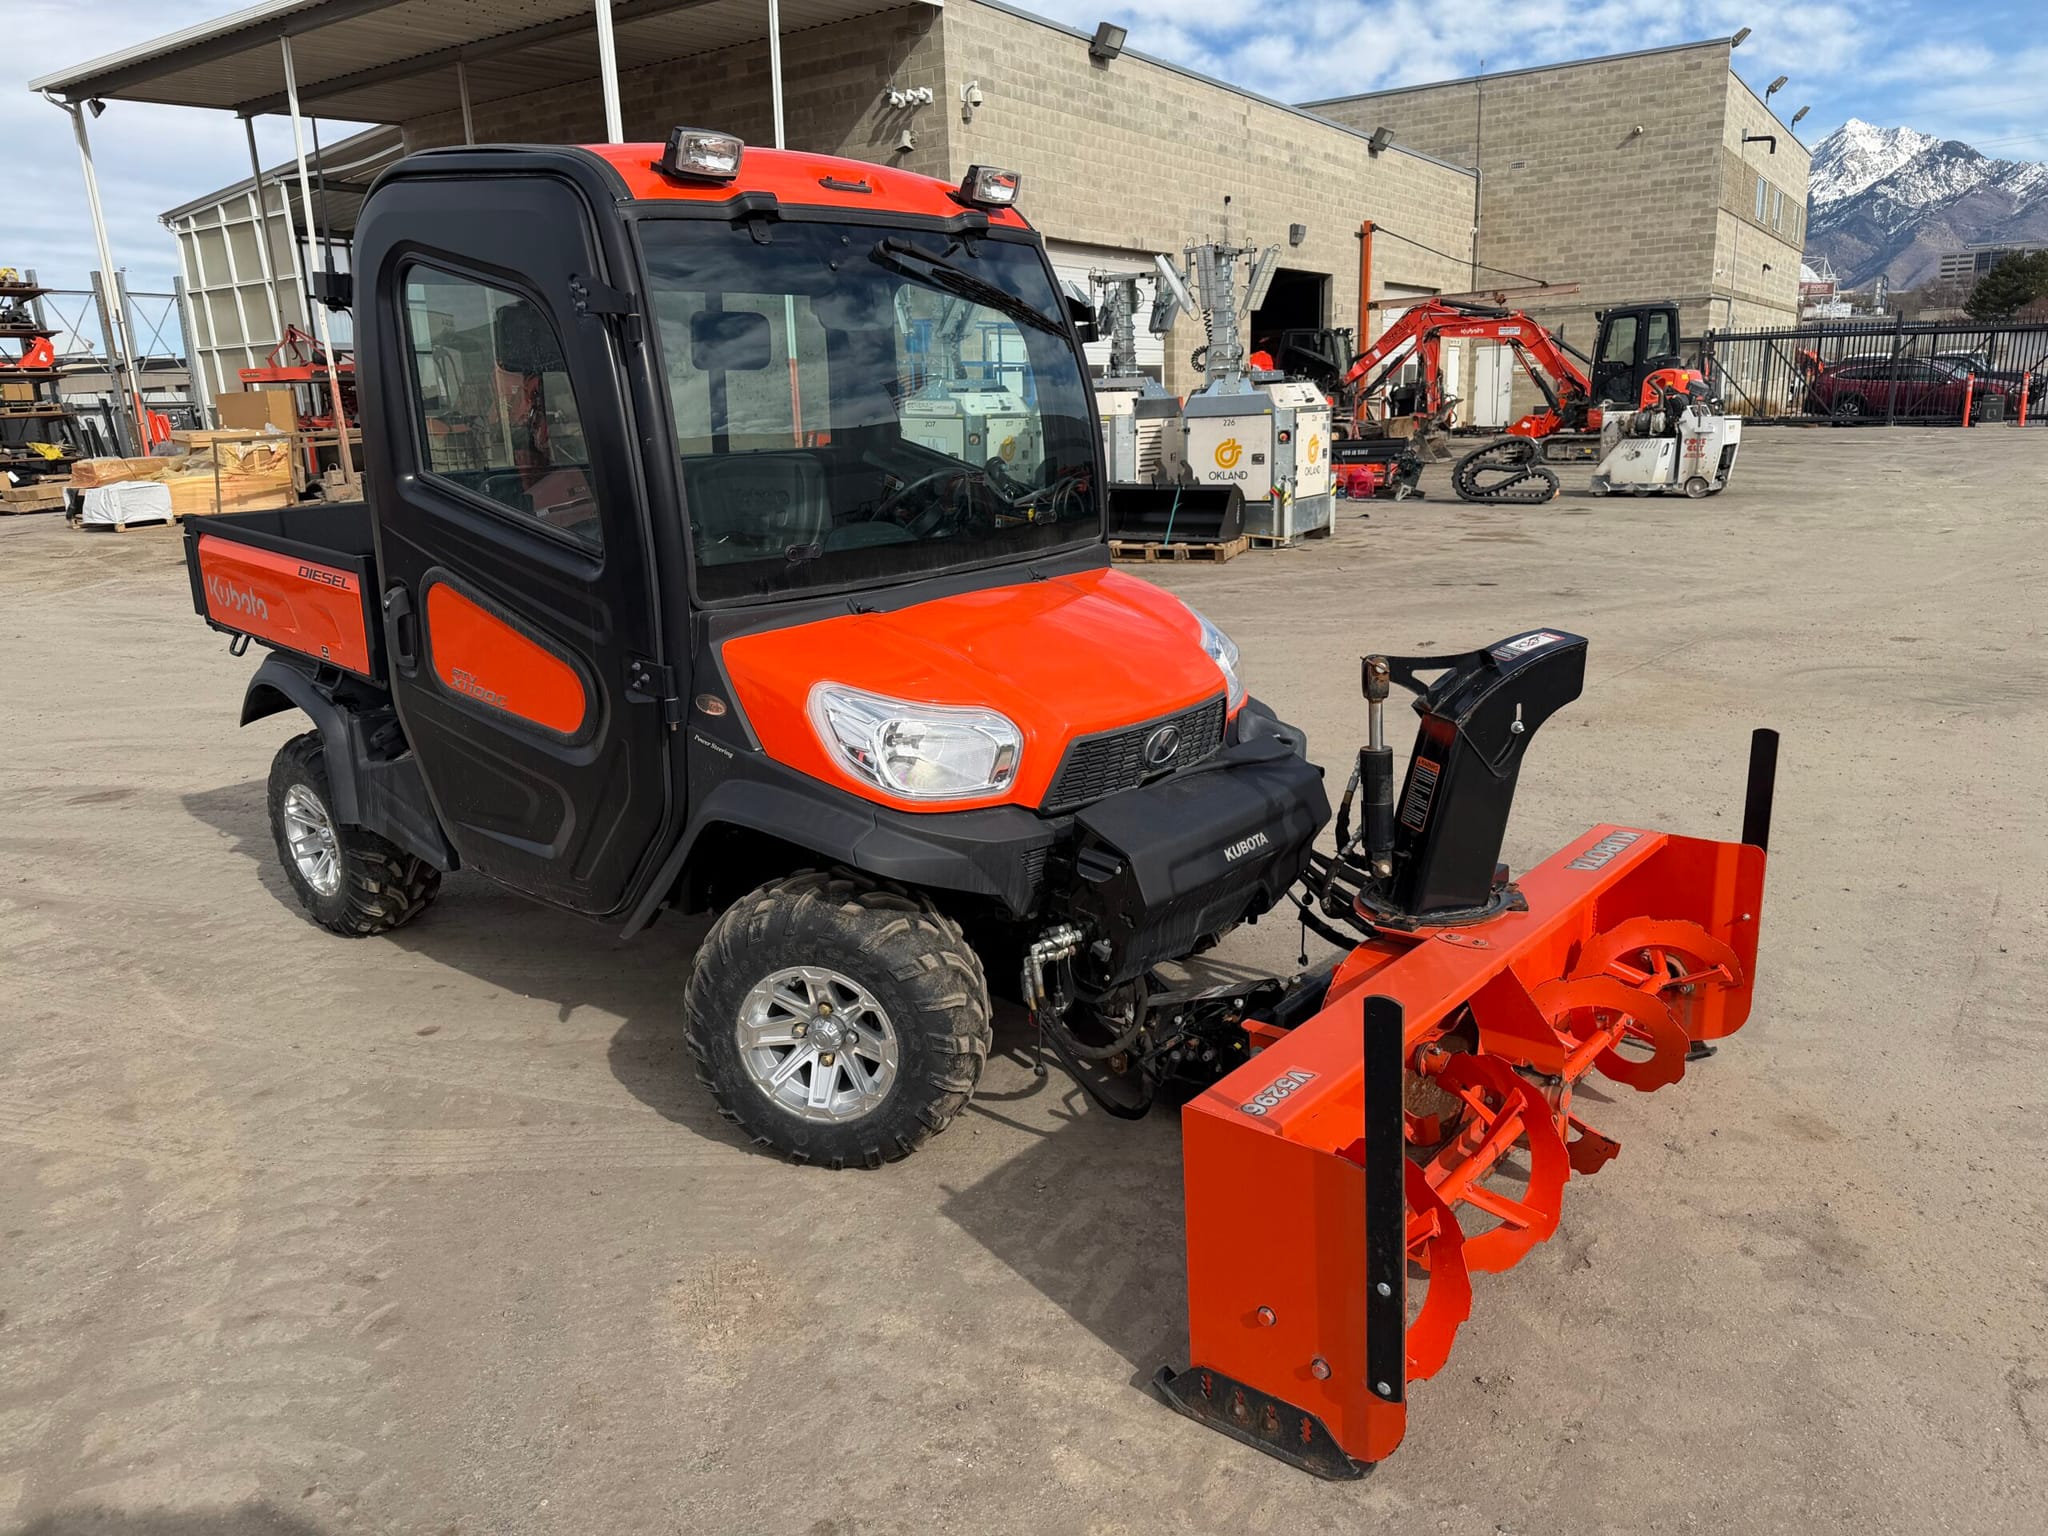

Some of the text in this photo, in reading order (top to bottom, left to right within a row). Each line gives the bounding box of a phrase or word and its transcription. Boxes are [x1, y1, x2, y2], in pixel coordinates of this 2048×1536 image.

[1223, 418, 1236, 427] 226
[1208, 470, 1248, 481] OKLAND
[298, 565, 351, 590] DIESEL
[207, 574, 269, 621] Kubota
[1223, 831, 1269, 863] KUBOTA
[1564, 830, 1645, 872] KUBOTA
[1239, 1069, 1317, 1117] V5296
